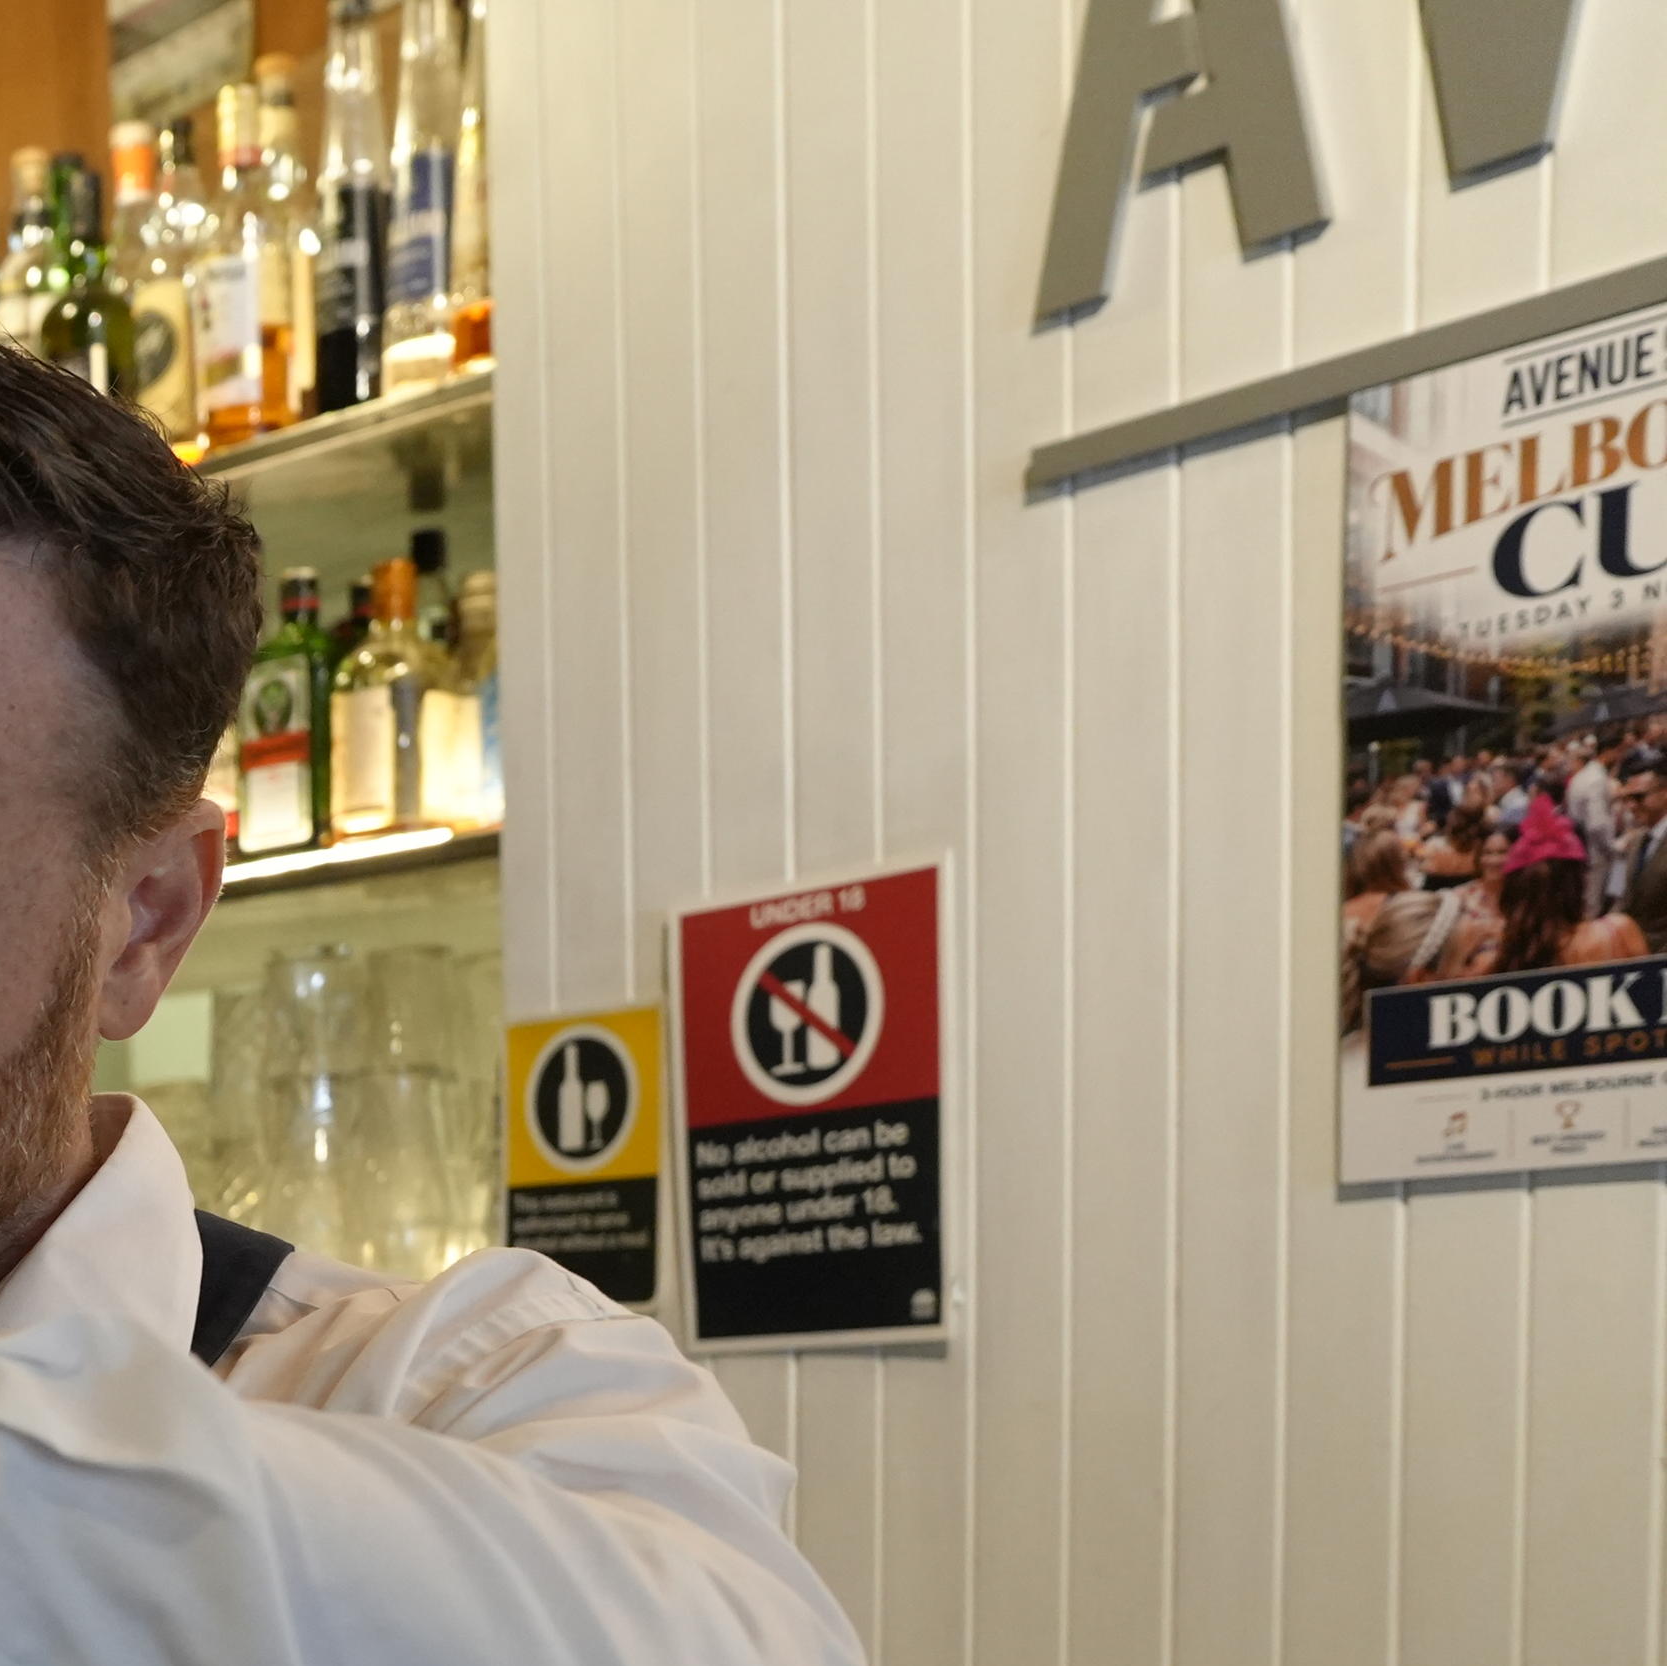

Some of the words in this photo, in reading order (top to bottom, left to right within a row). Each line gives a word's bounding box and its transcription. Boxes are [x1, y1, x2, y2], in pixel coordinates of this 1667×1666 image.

[1502, 329, 1657, 416] AVENUE
[1458, 595, 1592, 639] TUESDAY
[749, 889, 834, 930] UNDER
[838, 884, 866, 914] 18
[1427, 971, 1646, 1048] BOOK
[696, 1141, 730, 1168] No
[733, 1127, 821, 1165] alcohol
[823, 1127, 871, 1154] can
[874, 1119, 909, 1148] be
[697, 1168, 748, 1199] sold
[750, 1171, 777, 1195] or
[780, 1152, 885, 1193] supplied
[888, 1152, 917, 1179] to
[699, 1202, 783, 1235] anyone
[785, 1189, 857, 1223] under
[700, 1235, 735, 1262] It's
[737, 1226, 824, 1264] against
[827, 1223, 868, 1250] the
[871, 1219, 923, 1248] law.
